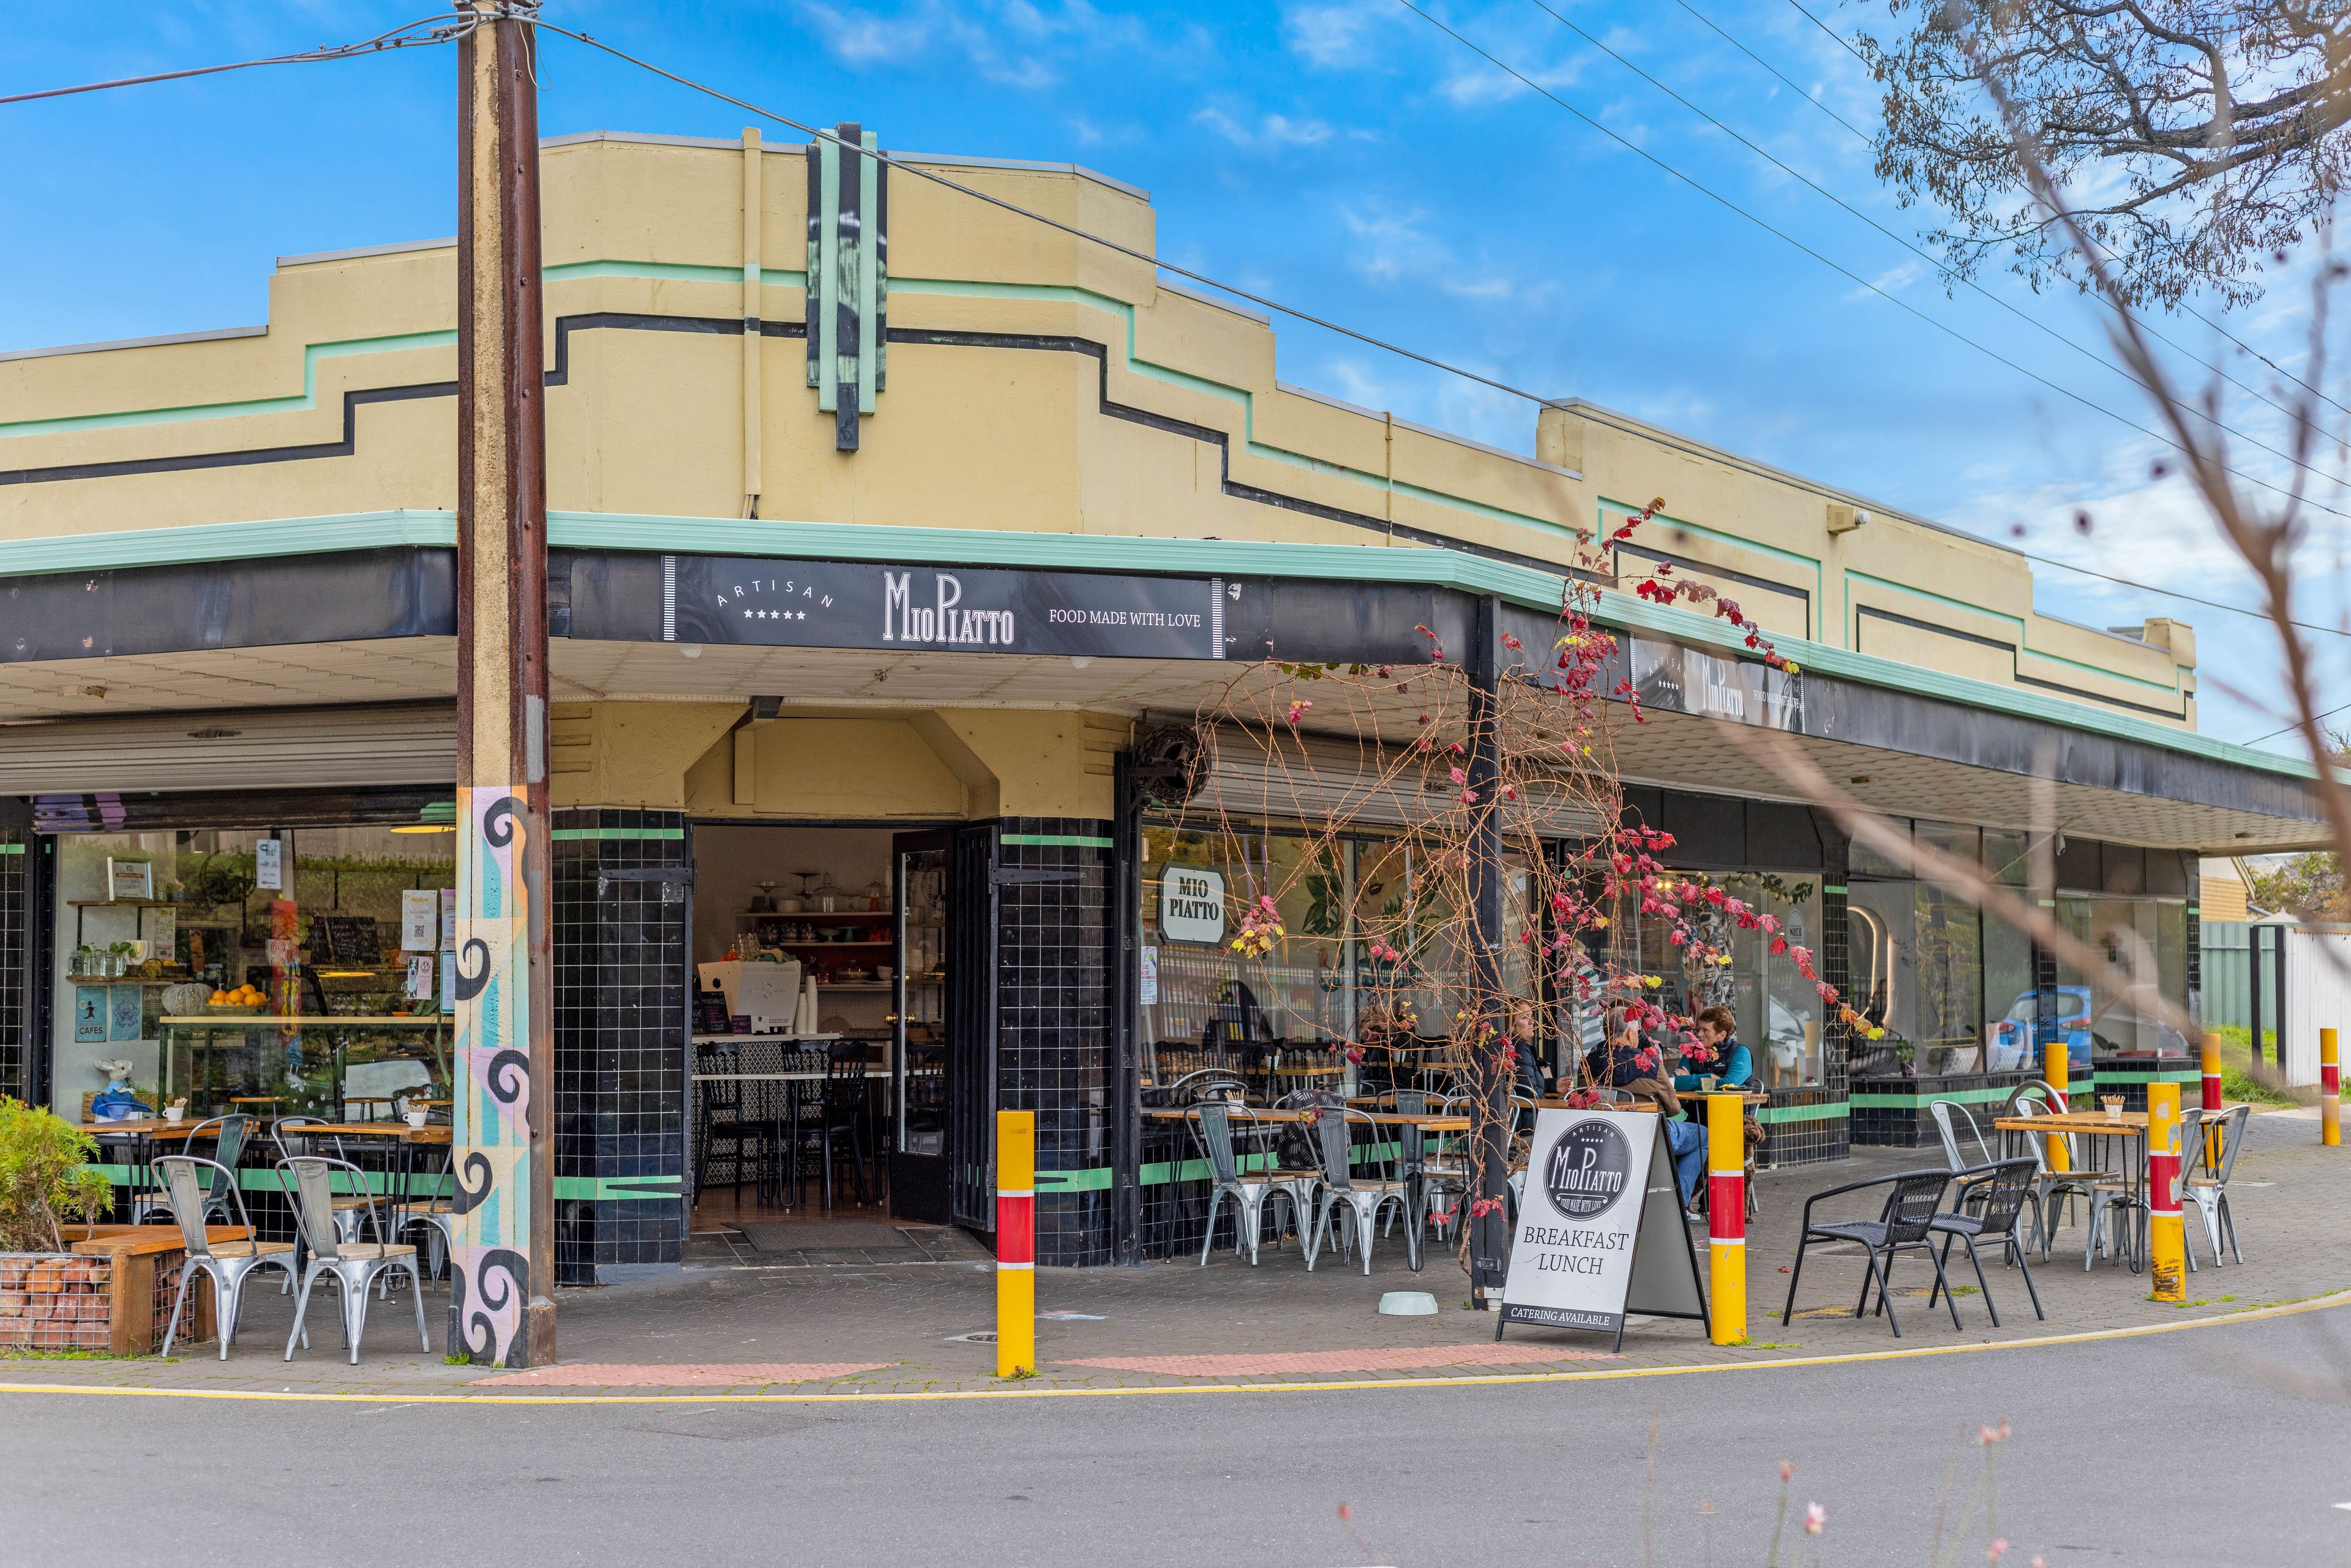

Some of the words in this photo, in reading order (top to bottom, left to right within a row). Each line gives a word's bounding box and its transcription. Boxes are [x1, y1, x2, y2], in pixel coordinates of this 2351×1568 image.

[716, 579, 833, 608] ARTISAN
[1049, 609, 1086, 623] FOOD
[1089, 610, 1127, 625] MADE
[1130, 612, 1164, 626] WITH
[1168, 613, 1201, 627] LOVE
[1649, 656, 1687, 681] ARTISAN
[1753, 689, 1767, 702] FOOD
[1767, 692, 1779, 704] MADE
[1778, 694, 1789, 707] WITH
[1788, 697, 1800, 709] LOVE
[1178, 876, 1209, 898] MIO
[1169, 898, 1220, 921] PIATTO
[1790, 928, 1802, 937] NUCO
[1572, 1125, 1615, 1138] ARTISAN
[1561, 1198, 1570, 1210] FOOD
[1569, 1199, 1581, 1212] MADE
[1581, 1199, 1592, 1212] WITH
[1591, 1200, 1602, 1211] LOVE
[1523, 1226, 1629, 1250] BREAKFAST
[1537, 1253, 1604, 1275] LUNCH
[1511, 1307, 1558, 1321] CATERING
[1559, 1312, 1610, 1326] AVAILABLE
